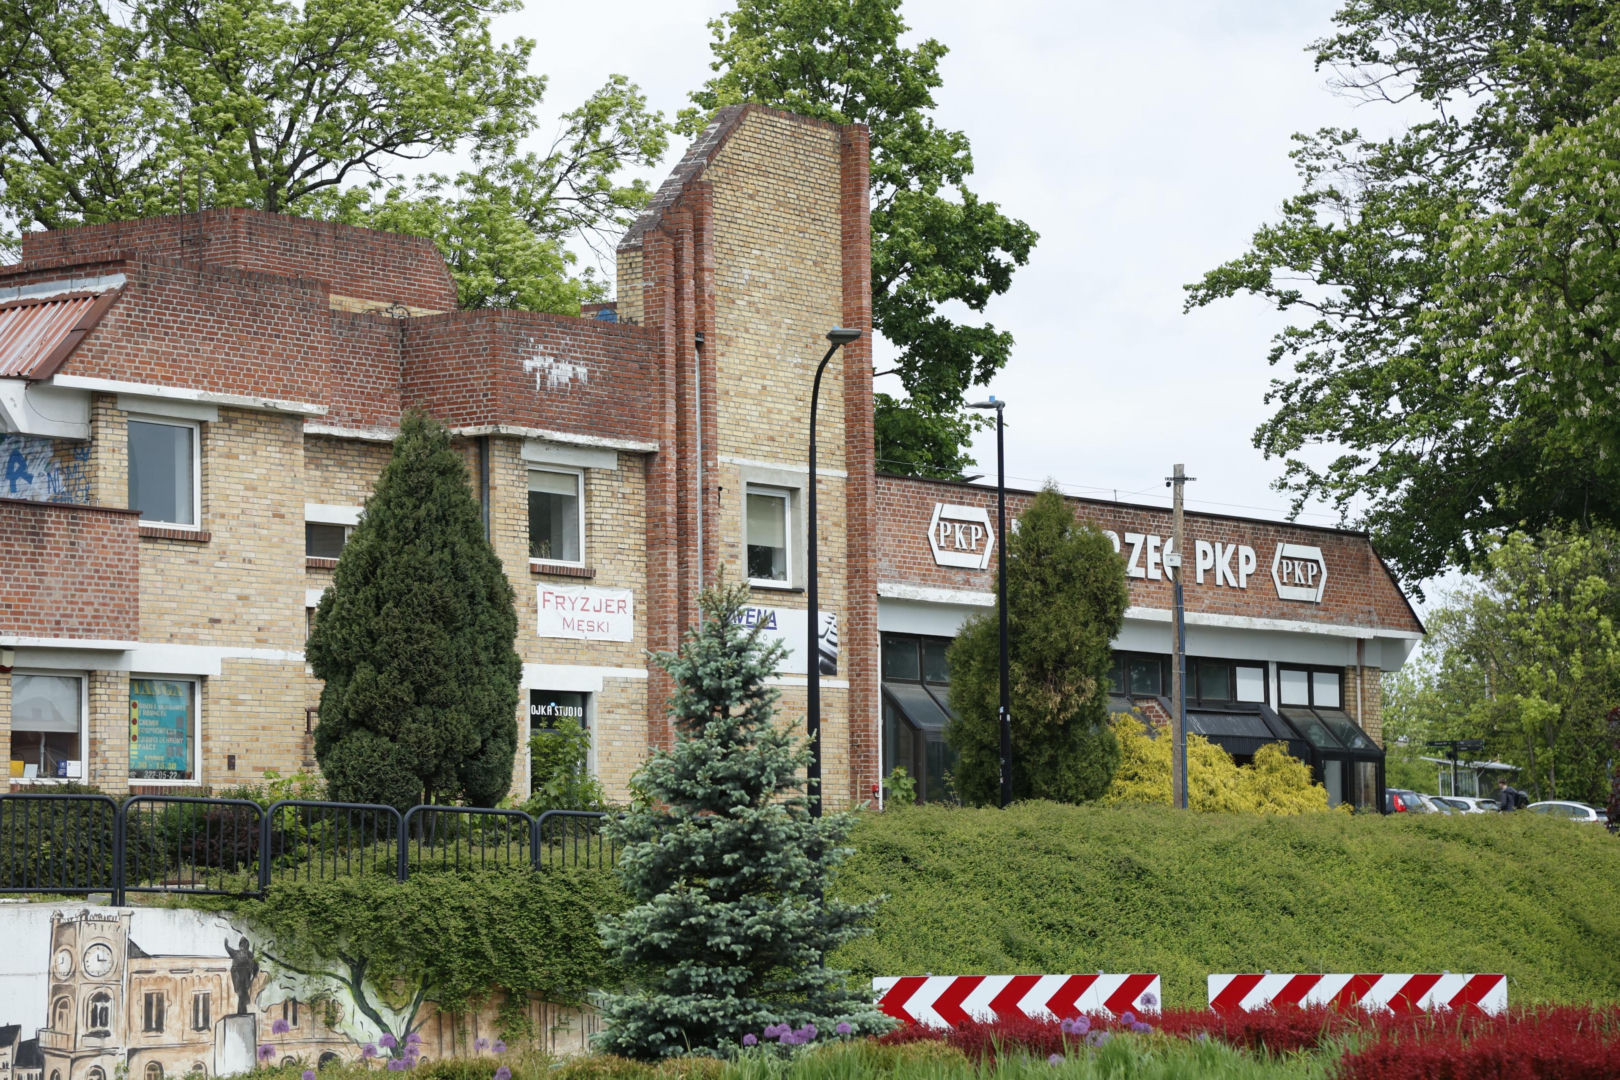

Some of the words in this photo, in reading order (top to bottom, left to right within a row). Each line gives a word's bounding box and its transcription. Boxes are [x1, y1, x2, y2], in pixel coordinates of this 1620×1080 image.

[938, 521, 983, 550] PKP
[1195, 540, 1257, 588] PKP
[1281, 560, 1318, 585] PKP
[554, 706, 583, 717] STUDIO
